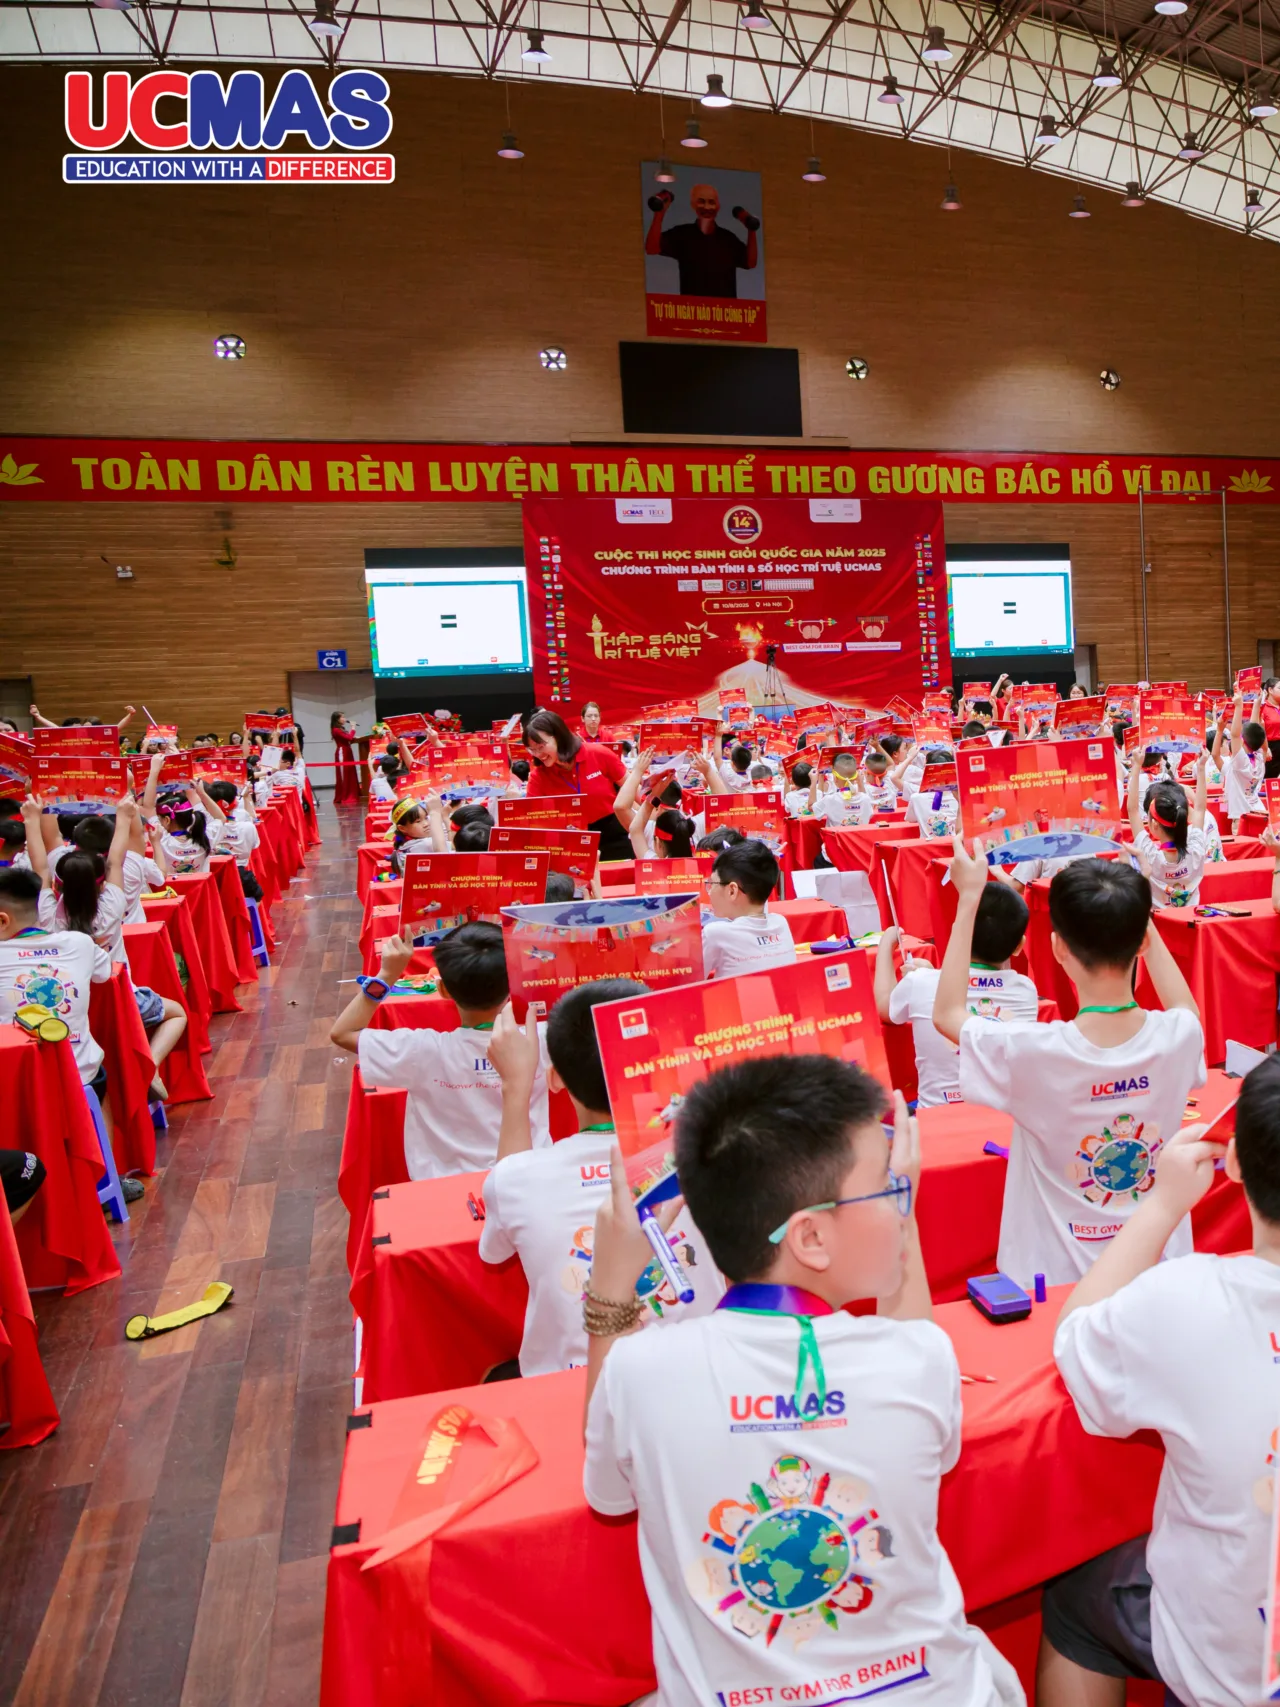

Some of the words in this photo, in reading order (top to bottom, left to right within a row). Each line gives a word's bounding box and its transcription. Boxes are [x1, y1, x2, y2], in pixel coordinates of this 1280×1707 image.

[72, 451, 201, 491] TOÀN
[217, 453, 312, 492] DÂN
[327, 453, 415, 492] RÈN
[429, 456, 558, 498] LUYỆN
[571, 457, 674, 493] THÂN
[685, 453, 755, 493] THỂ
[766, 465, 856, 494] THEO
[868, 463, 984, 495] GƯƠNG
[997, 464, 1060, 495] BÁC
[1072, 458, 1112, 495] HỒ
[1123, 464, 1151, 496] VĨ
[1160, 467, 1211, 501] ĐẠI
[594, 549, 633, 562] CUỘC
[636, 550, 659, 560] THI
[662, 550, 691, 561] HỌC
[694, 550, 726, 559] SINH
[729, 547, 756, 559] GIỎI
[760, 546, 798, 560] QUỐC
[800, 549, 823, 558] GIA
[826, 547, 855, 558] NĂM
[857, 548, 886, 557] 2025
[601, 565, 652, 575] CHƯƠNG
[654, 563, 689, 574] TRÌNH
[692, 563, 716, 574] BÀN
[718, 563, 744, 574] TÍNH
[747, 564, 756, 573] &
[758, 562, 773, 573] SỐ
[776, 564, 799, 574] HỌC
[801, 562, 819, 572] TRÍ
[821, 561, 842, 574] TUỆ
[844, 563, 882, 572] UCMAS
[664, 645, 702, 658] VIỆT
[323, 657, 343, 667] C1
[1165, 868, 1188, 879] UCMAS
[18, 949, 58, 958] UCMAS
[969, 977, 1003, 988] CMAS
[694, 1023, 752, 1047] CHƯƠNG
[755, 1011, 794, 1034] TRÌNH
[624, 1057, 655, 1079] BÀN
[657, 1049, 690, 1073] TÍNH
[693, 1043, 713, 1063] VÀ
[715, 1036, 735, 1059] SỐ
[737, 1034, 765, 1054] HỌC
[769, 1024, 789, 1046] TRÍ
[790, 1020, 816, 1041] TUỆ
[817, 1011, 863, 1032] UCMAS
[1092, 1076, 1149, 1096] UCMAS
[1074, 1224, 1098, 1234] BEST
[730, 1390, 845, 1421] UCMAS
[729, 1686, 773, 1707] BEST
[780, 1680, 822, 1702] GYM
[824, 1673, 852, 1693] FOR
[857, 1652, 917, 1684] BRAIN
